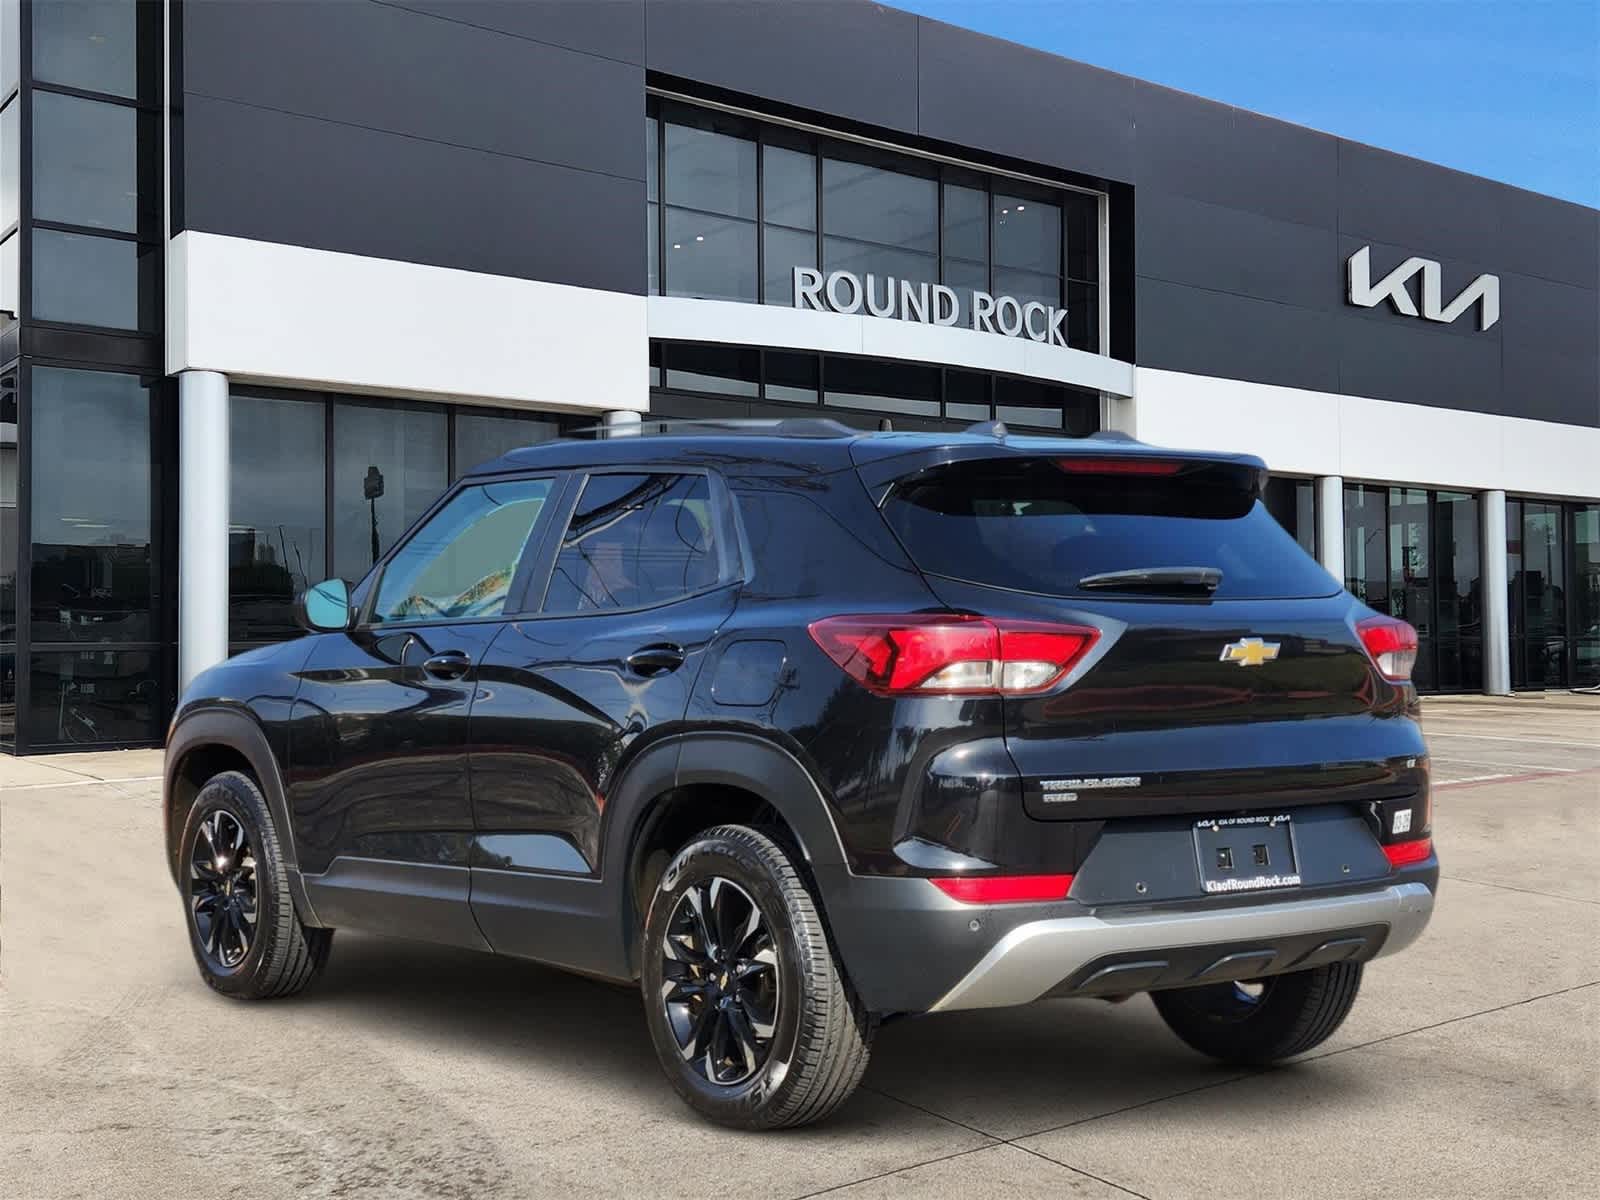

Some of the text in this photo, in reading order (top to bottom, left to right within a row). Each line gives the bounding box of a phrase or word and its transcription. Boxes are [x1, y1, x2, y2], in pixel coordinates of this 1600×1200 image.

[792, 266, 1069, 347] ROUND ROCK
[1348, 246, 1500, 331] KIA
